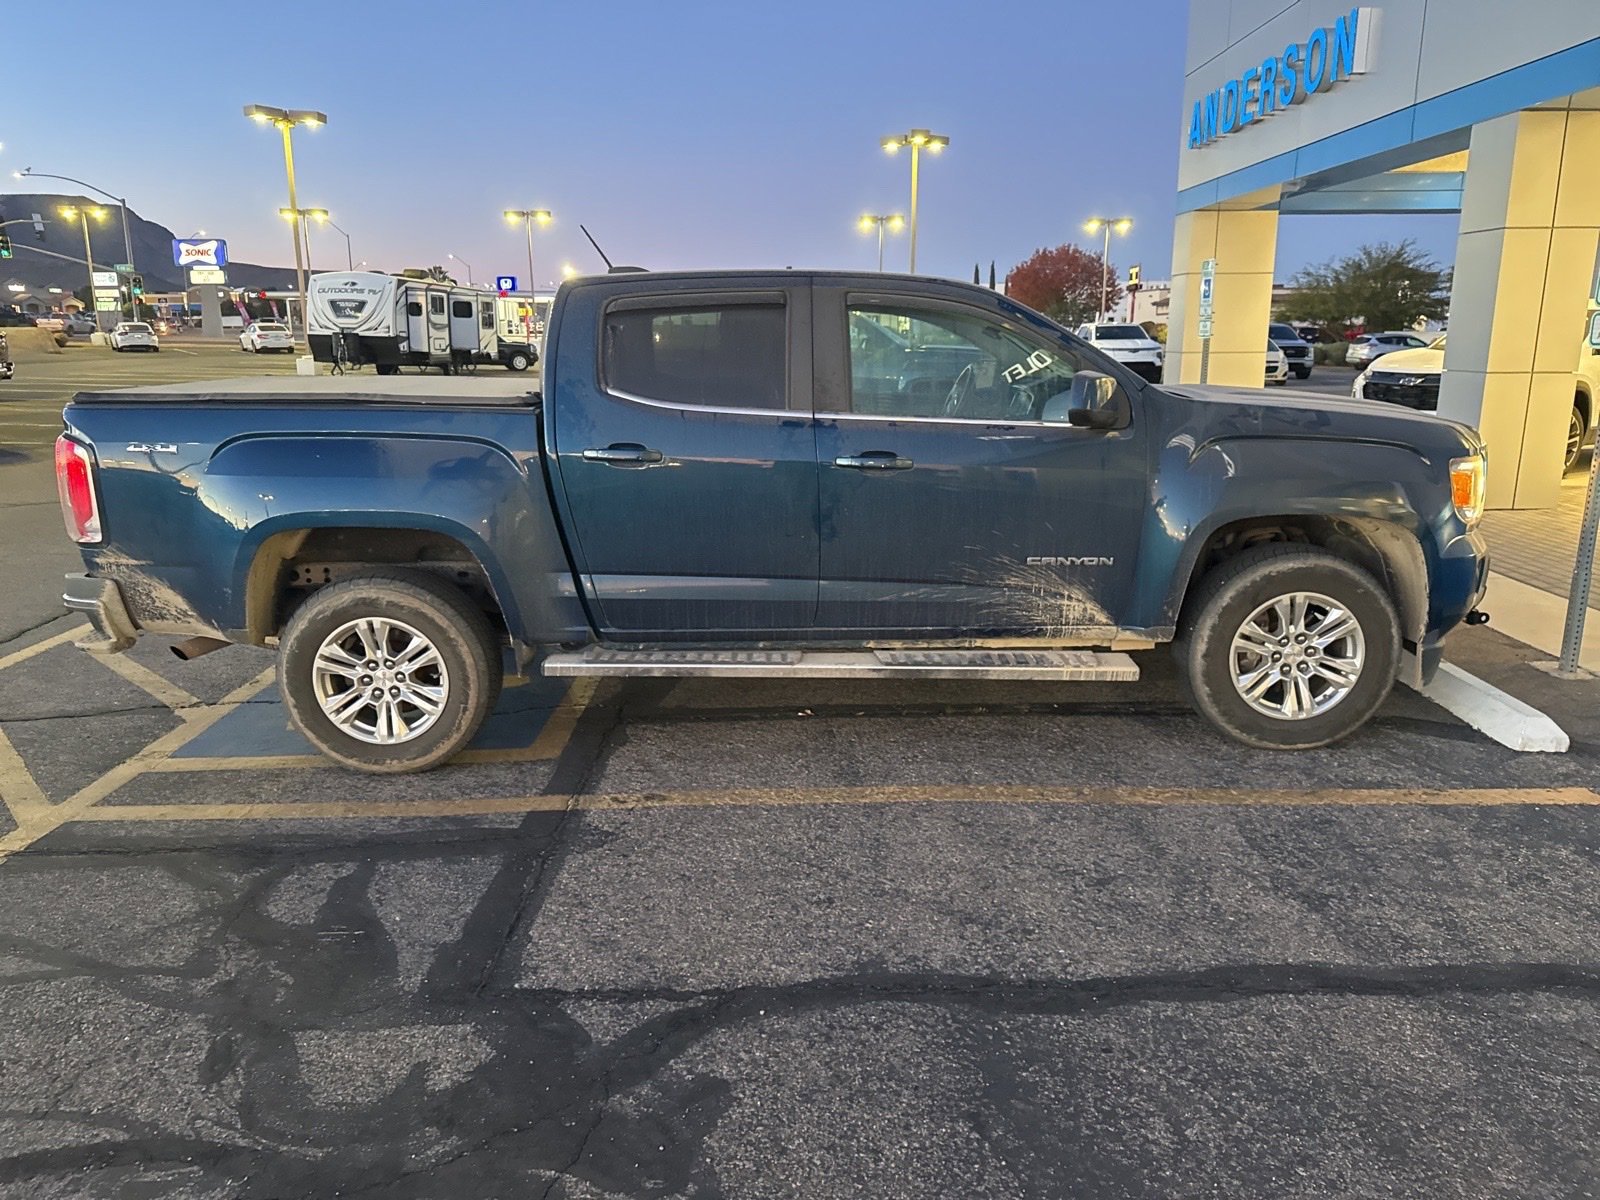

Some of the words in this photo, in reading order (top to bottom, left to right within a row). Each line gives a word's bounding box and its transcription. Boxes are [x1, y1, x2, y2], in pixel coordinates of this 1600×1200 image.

[1188, 8, 1360, 150] ANDERSON
[184, 248, 212, 257] SONIC
[1026, 556, 1114, 566] CANYON
